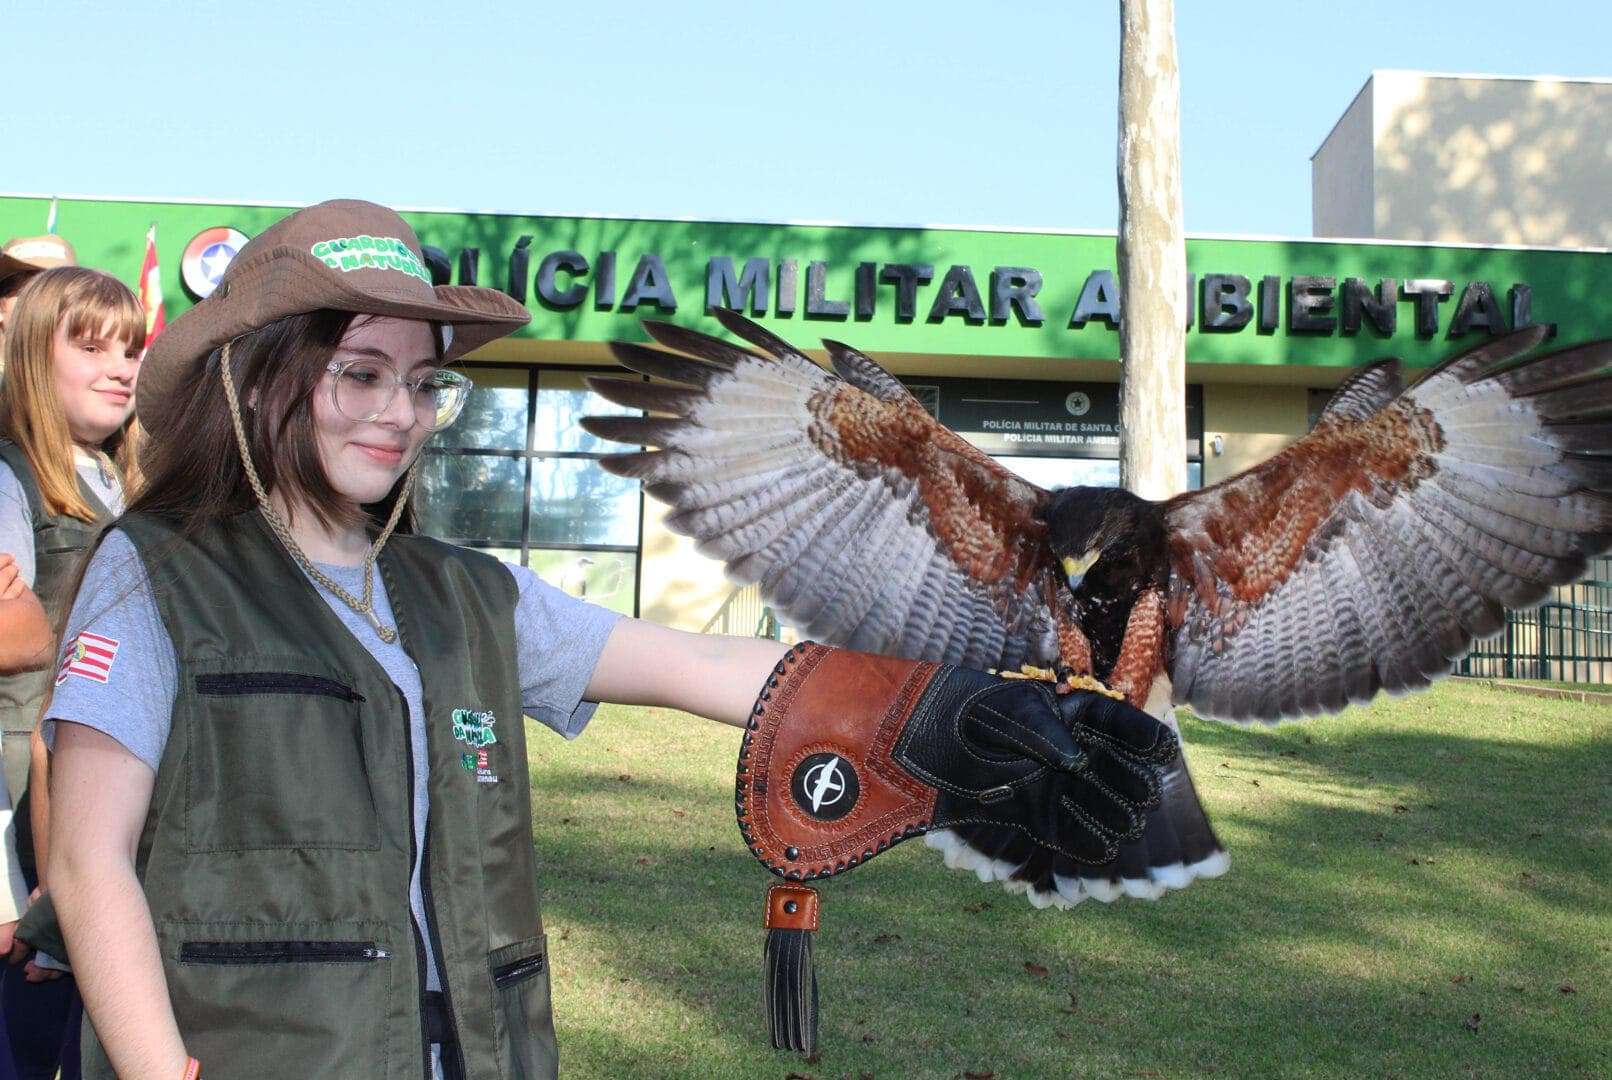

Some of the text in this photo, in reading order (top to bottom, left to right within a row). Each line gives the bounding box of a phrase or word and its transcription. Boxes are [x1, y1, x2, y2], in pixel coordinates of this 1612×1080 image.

[705, 256, 1045, 328] MILITAR
[1067, 269, 1556, 339] ABIENTAL
[983, 419, 1021, 430] POLÍCIA
[1023, 421, 1062, 431] MILITAR
[1066, 422, 1077, 431] DE
[1080, 423, 1112, 433] SANTA
[1003, 433, 1042, 442] POLÍCIA
[1045, 434, 1083, 443] MILITAR
